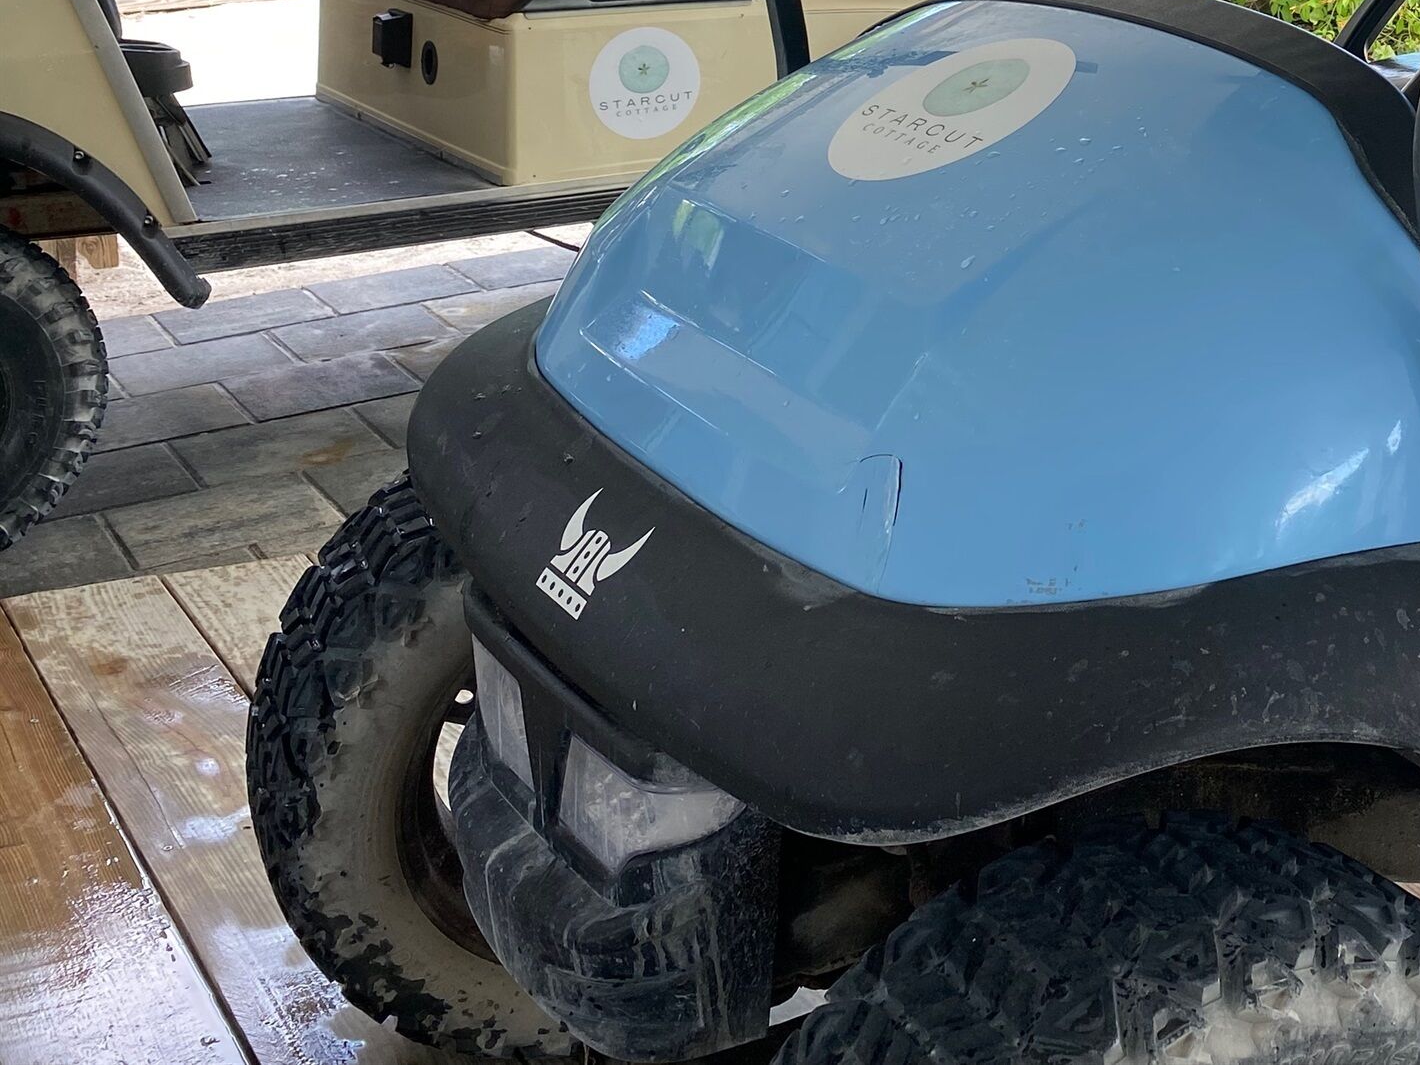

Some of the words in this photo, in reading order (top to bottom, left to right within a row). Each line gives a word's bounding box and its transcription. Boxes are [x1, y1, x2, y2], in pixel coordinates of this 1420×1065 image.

[600, 91, 692, 111] STARCUT
[616, 104, 677, 117] COTTAGE
[861, 105, 983, 149] STARCUT
[862, 122, 941, 154] COTTAGE
